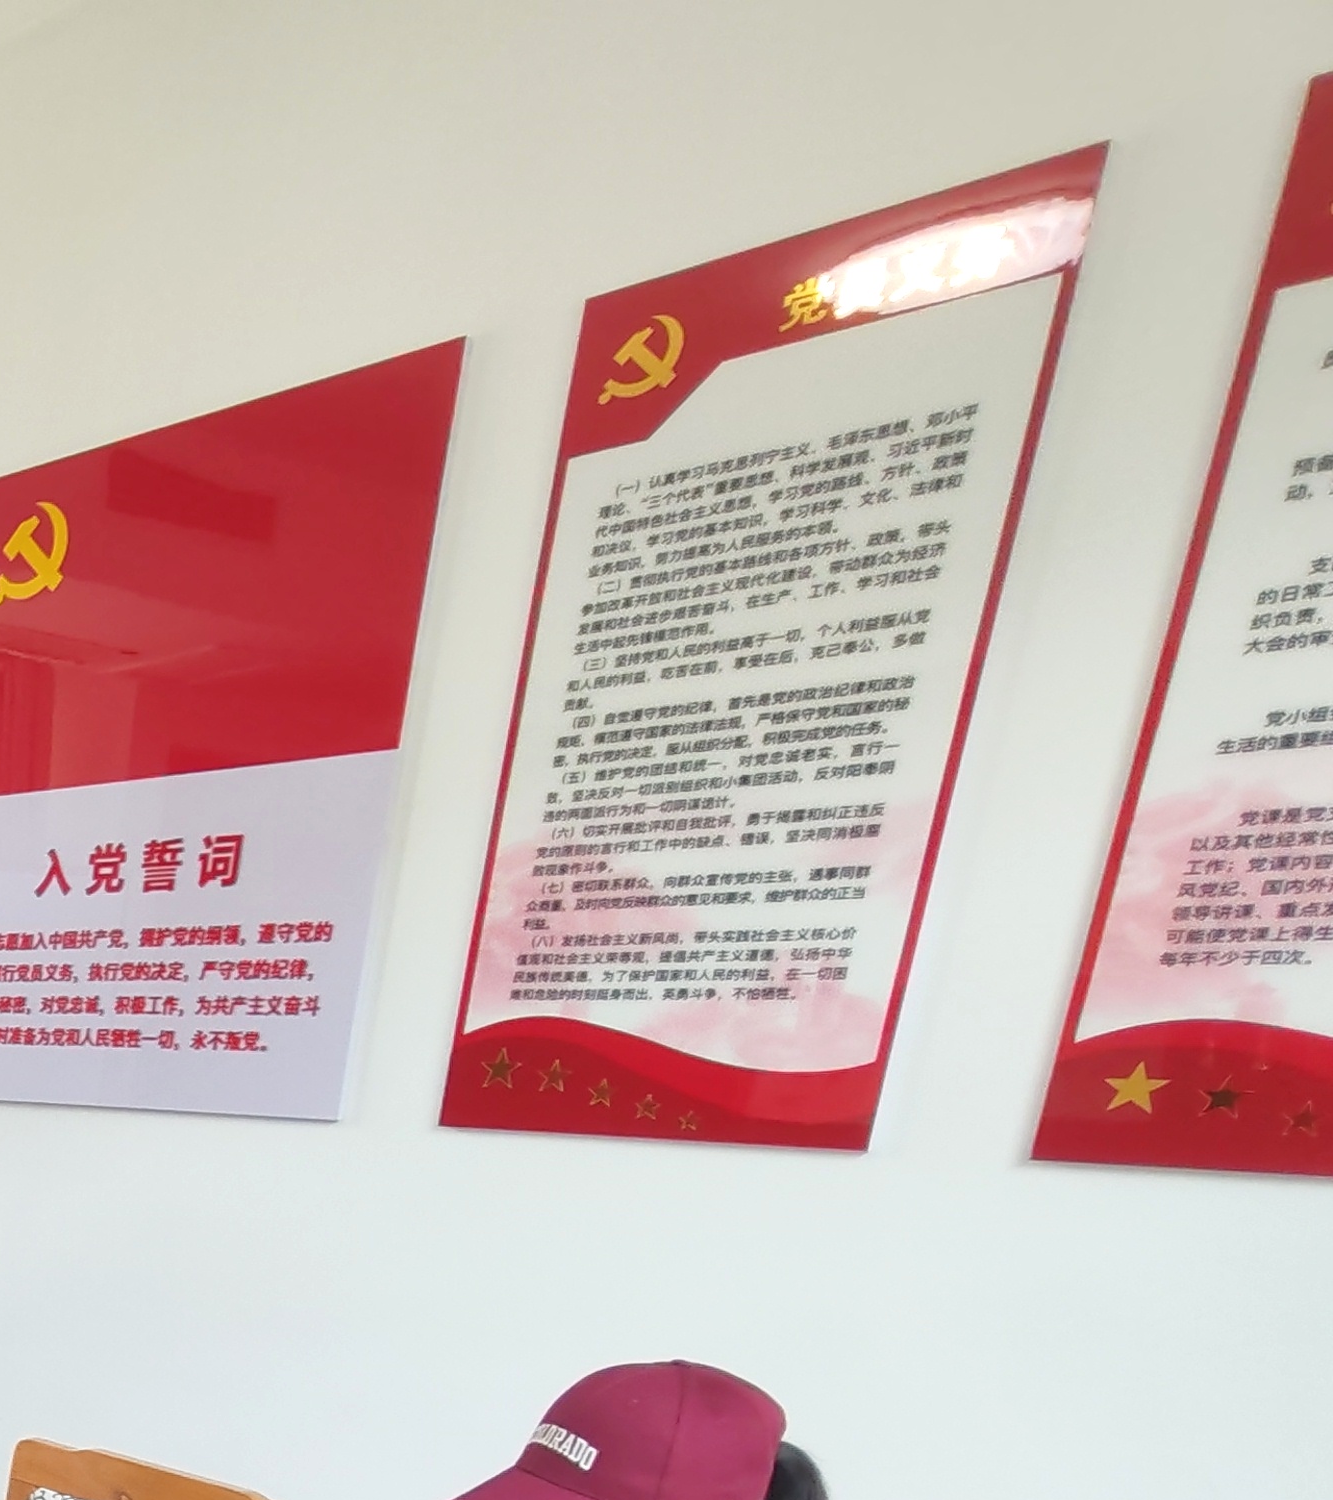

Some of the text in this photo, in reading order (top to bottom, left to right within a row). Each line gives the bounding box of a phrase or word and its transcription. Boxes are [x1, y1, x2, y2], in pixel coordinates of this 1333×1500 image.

[1244, 628, 1333, 655] 大会的审
[1265, 706, 1333, 728] 党小组
[34, 833, 245, 898] 入党誓词
